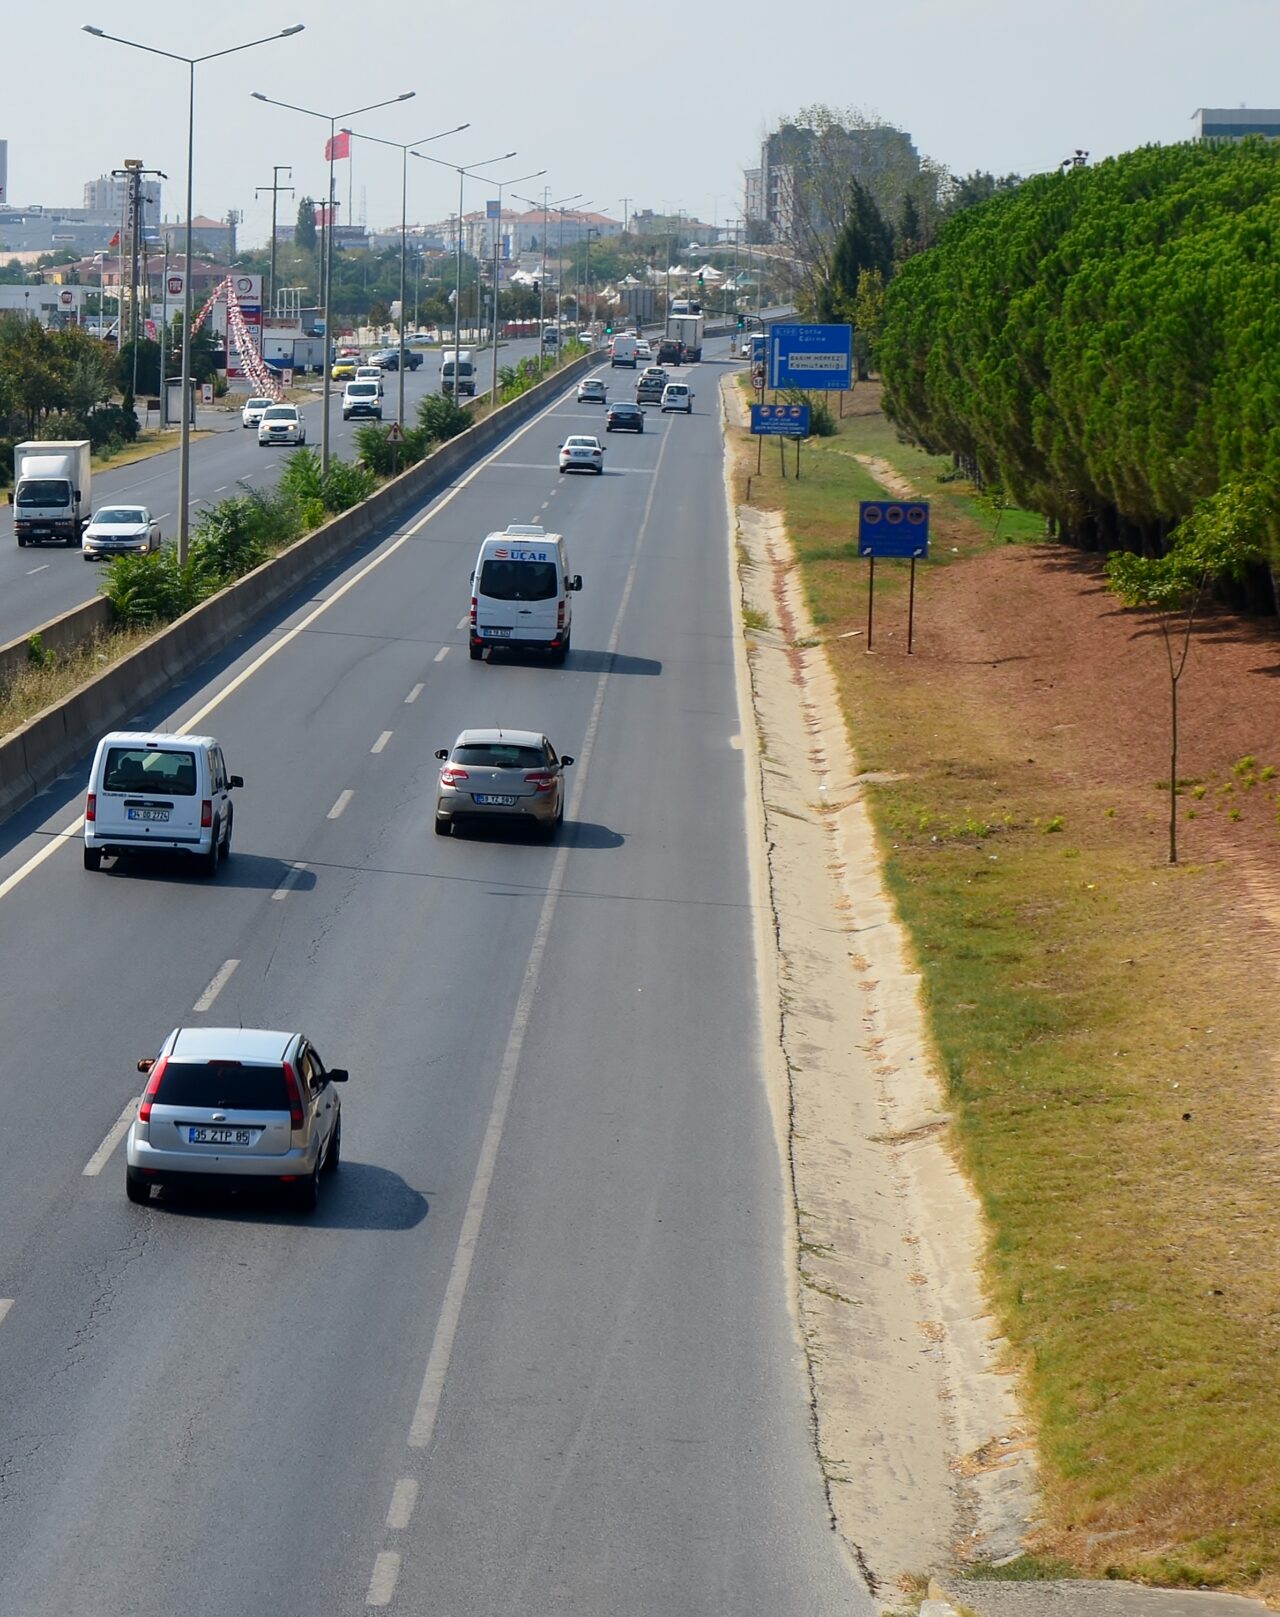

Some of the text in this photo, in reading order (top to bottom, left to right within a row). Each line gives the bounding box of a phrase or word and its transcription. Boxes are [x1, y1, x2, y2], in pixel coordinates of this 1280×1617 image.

[511, 551, 547, 561] UCAR
[195, 1129, 207, 1140] 35
[211, 1130, 232, 1141] ZTP
